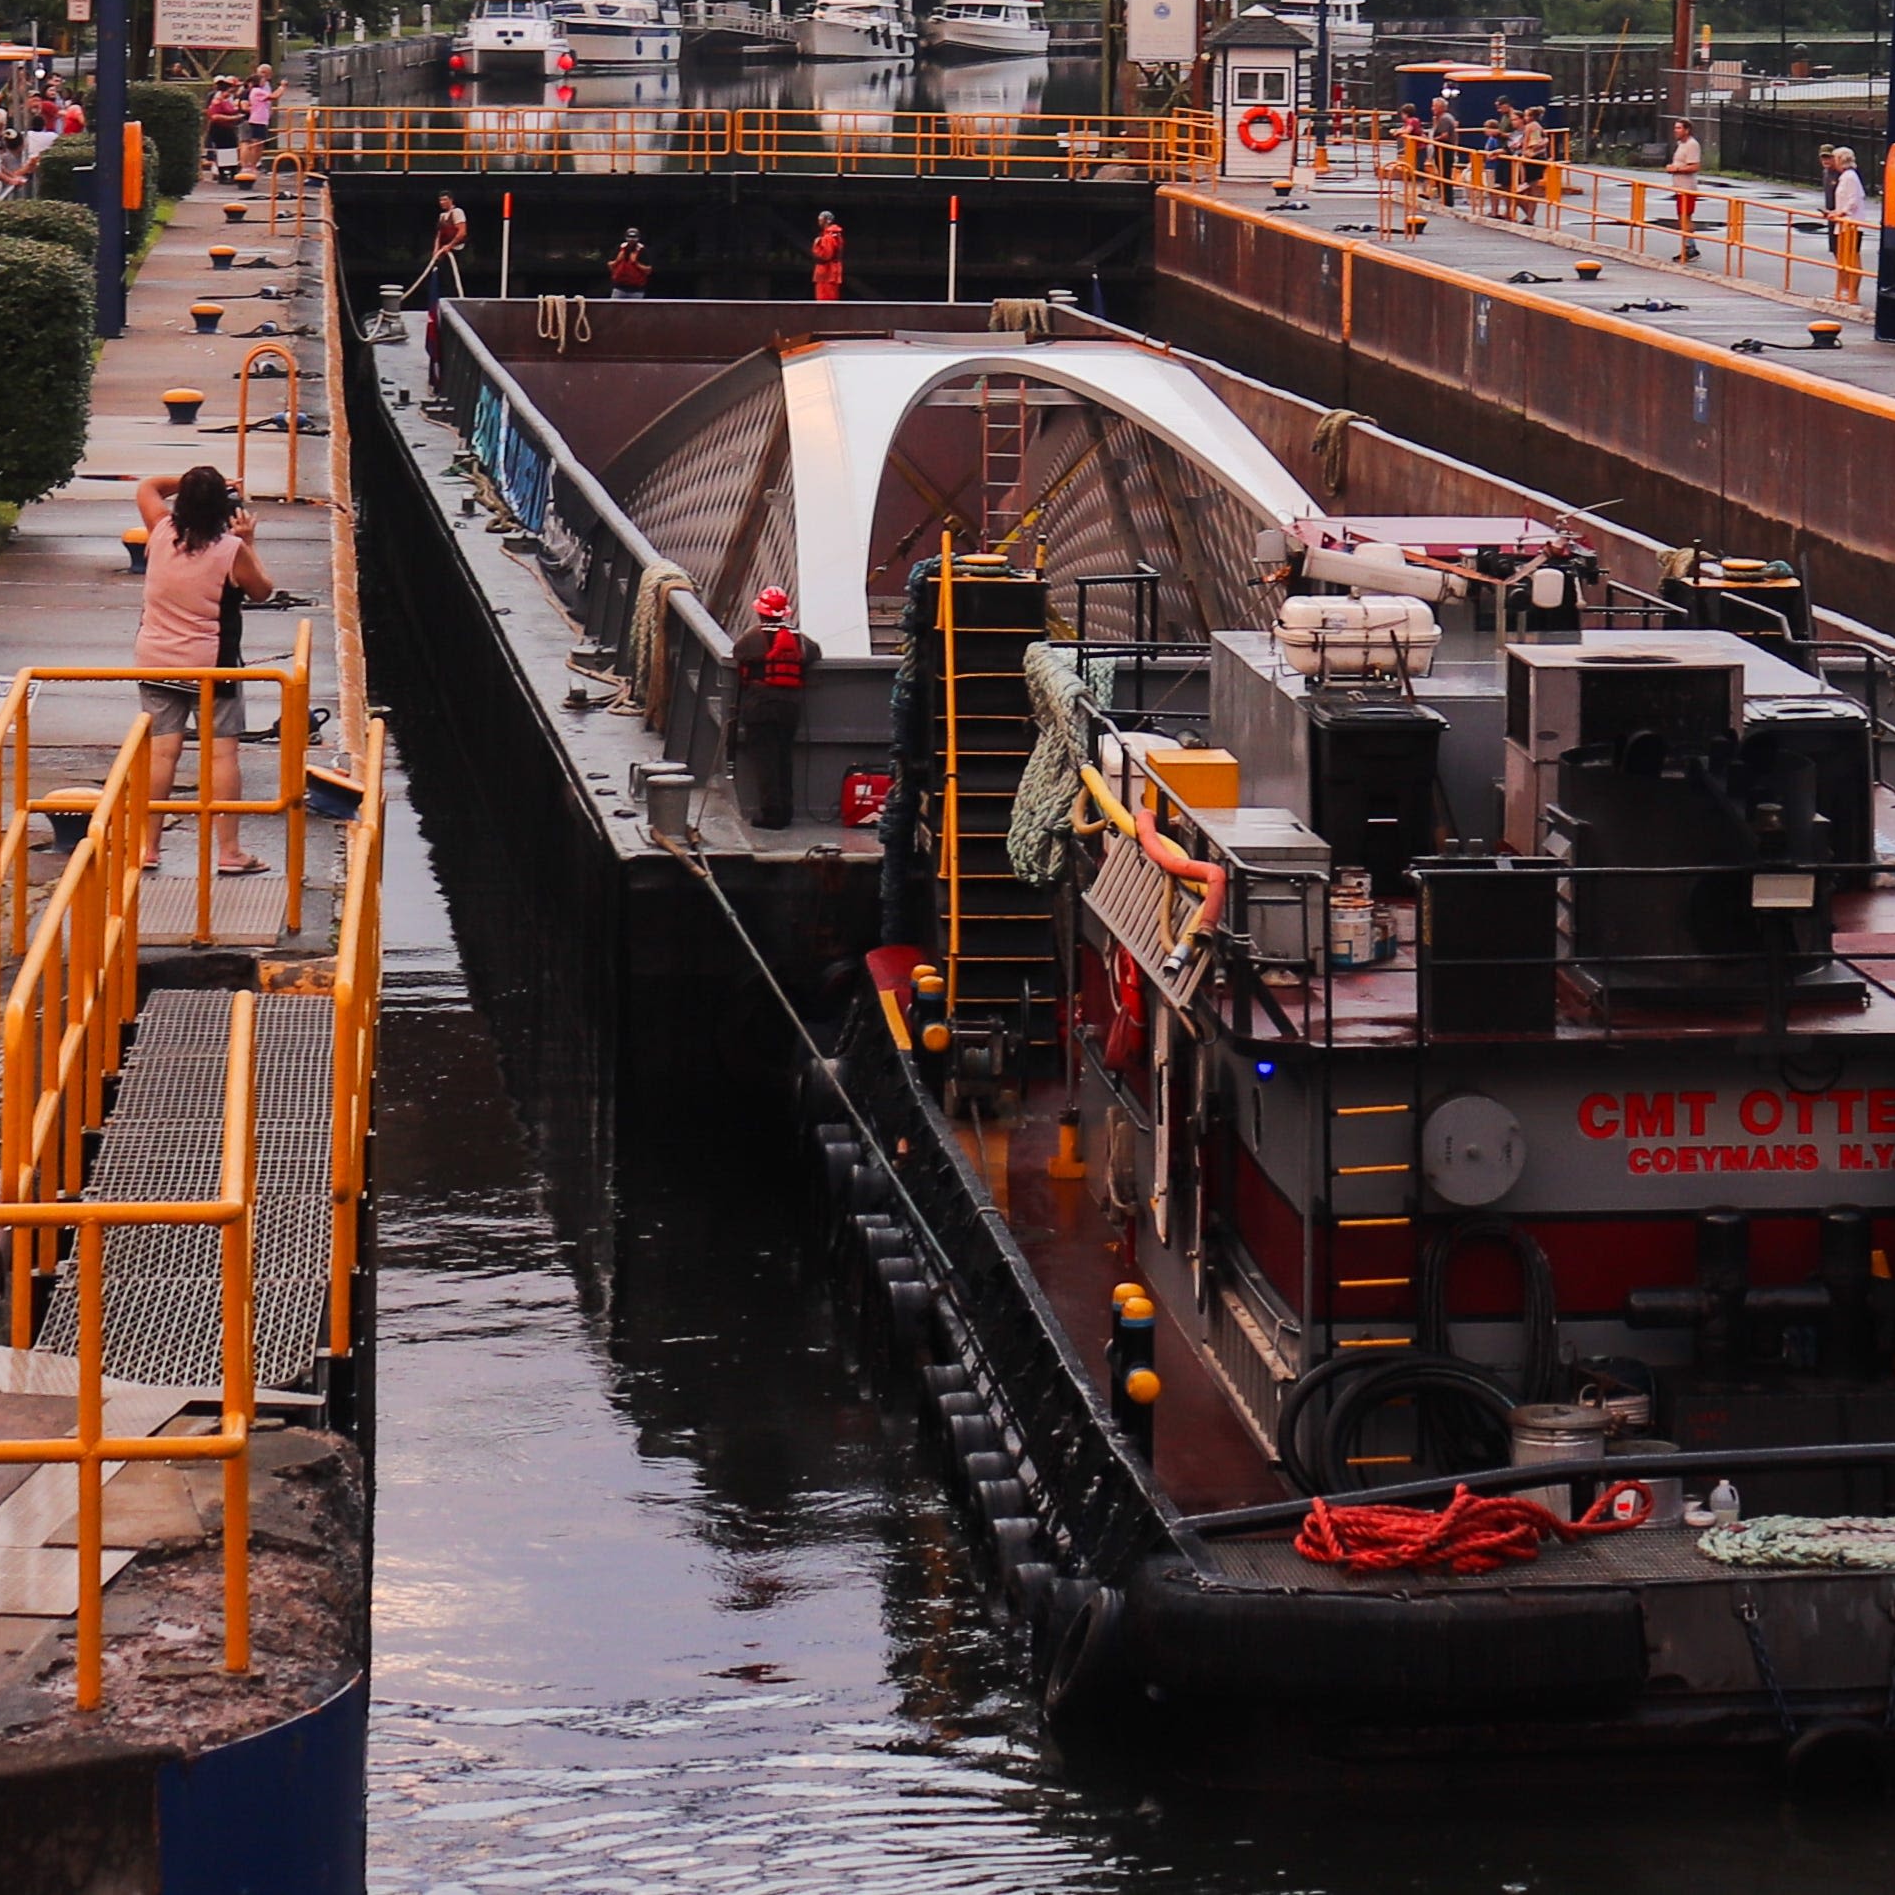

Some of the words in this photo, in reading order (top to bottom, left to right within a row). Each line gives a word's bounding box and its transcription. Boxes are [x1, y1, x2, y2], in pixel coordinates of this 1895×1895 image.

[161, 0, 186, 8] CROSS
[190, 1, 224, 9] CURRENT
[227, 2, 253, 10] AHEAD
[162, 11, 222, 19] HYDRO-STATION
[225, 13, 251, 21] INTAKE
[171, 22, 189, 30] STAY
[206, 23, 219, 31] THE
[172, 33, 182, 41] OR
[187, 34, 239, 43] MID-CHANNEL
[1577, 1090, 1717, 1139] CMT
[1627, 1143, 1819, 1174] COEYMANS
